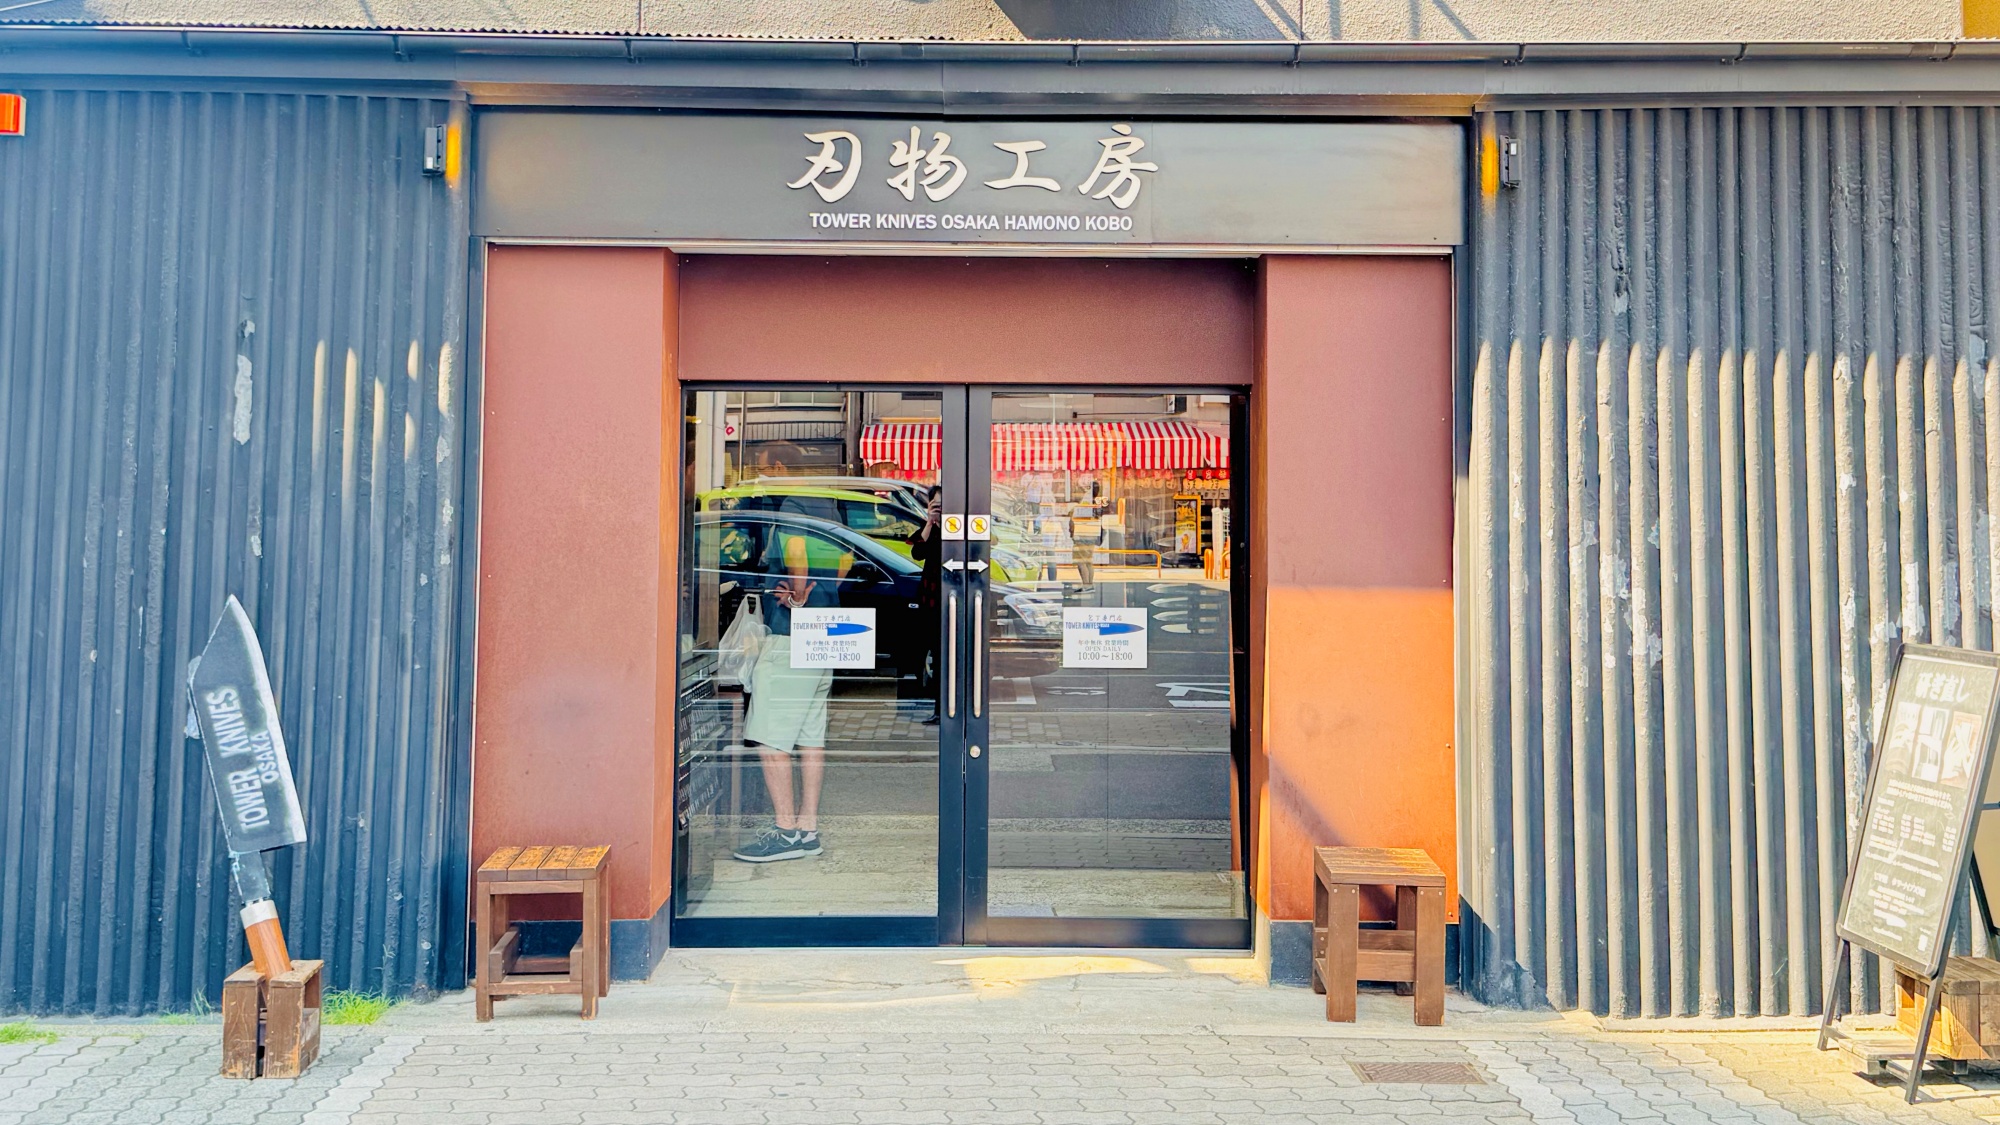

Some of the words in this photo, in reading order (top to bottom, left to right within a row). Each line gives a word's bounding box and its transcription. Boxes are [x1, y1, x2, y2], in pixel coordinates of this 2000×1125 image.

[786, 123, 1159, 209] 刃物工房
[809, 211, 871, 229] TOWER
[876, 212, 937, 230] KNIVES
[941, 214, 999, 231] OSAKA
[1004, 214, 1080, 231] HAMONO
[1085, 215, 1133, 231] KOBO
[1065, 622, 1081, 630] TOWER
[1082, 622, 1100, 630] KNIVES
[206, 688, 250, 758] KNIVES
[251, 731, 280, 784] OSAKA
[229, 768, 270, 833] TOWER
